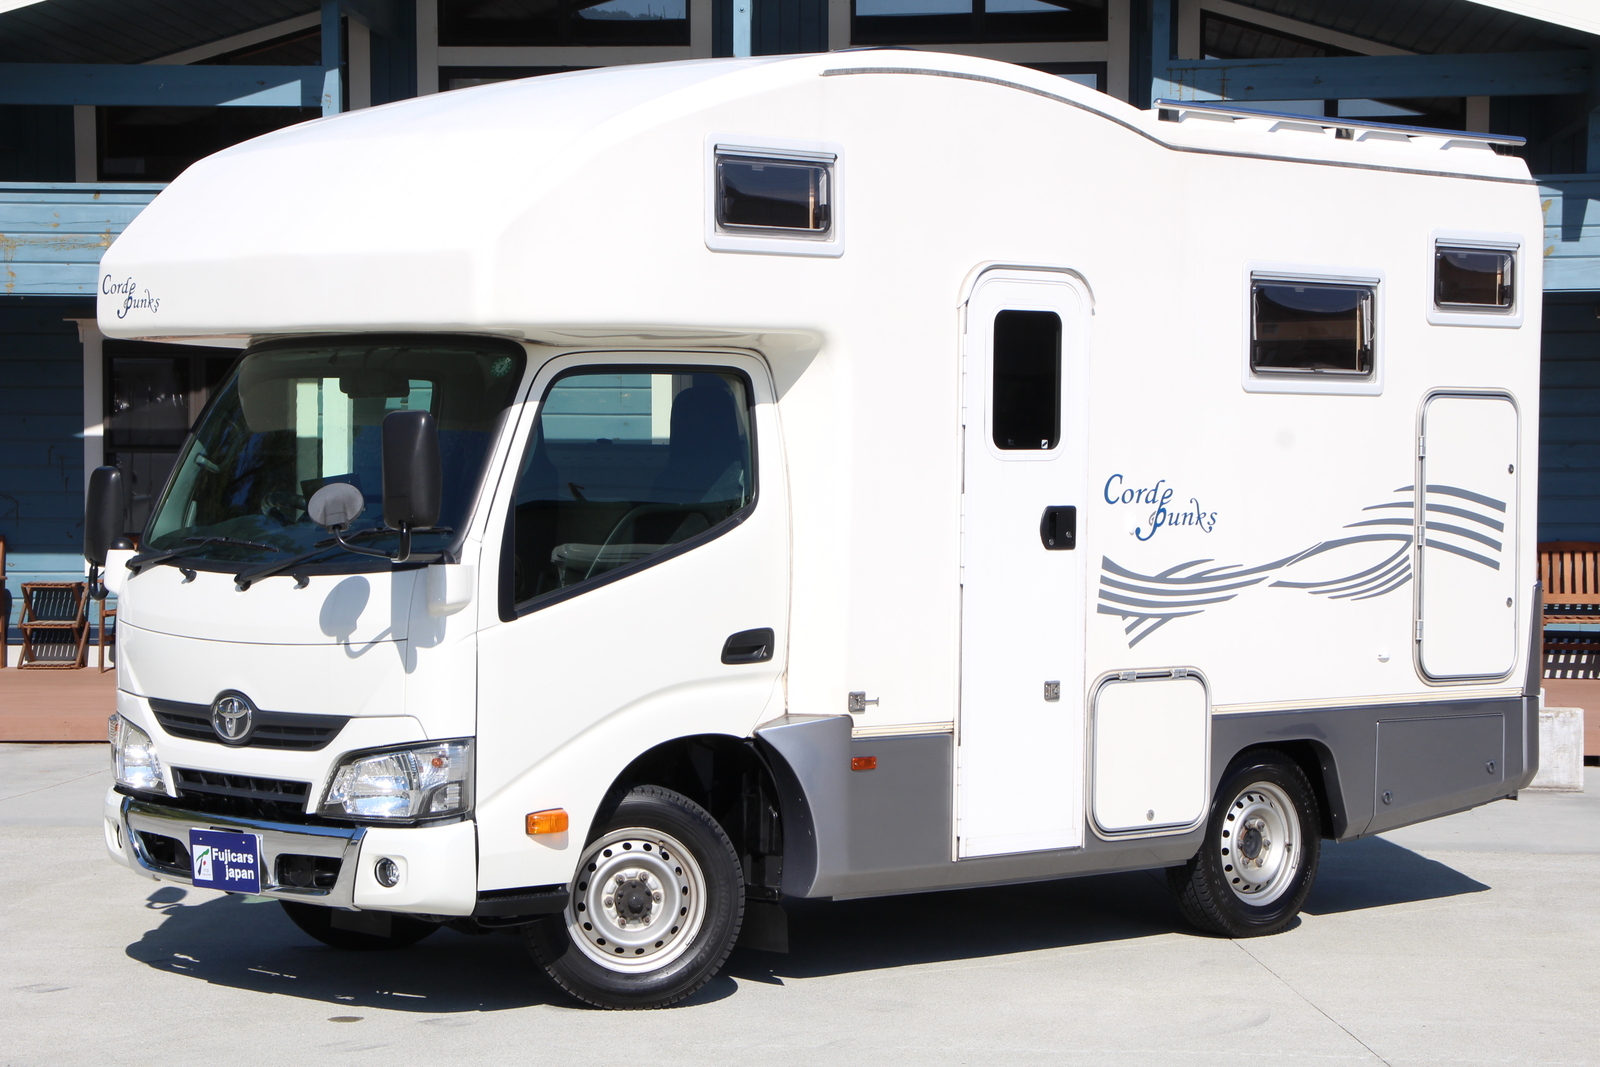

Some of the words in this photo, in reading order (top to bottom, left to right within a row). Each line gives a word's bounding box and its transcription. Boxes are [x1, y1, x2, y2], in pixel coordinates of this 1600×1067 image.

[102, 274, 137, 295] Corde
[1103, 473, 1174, 505] Corde
[212, 847, 254, 865] Fujicars
[225, 864, 255, 881] japan
